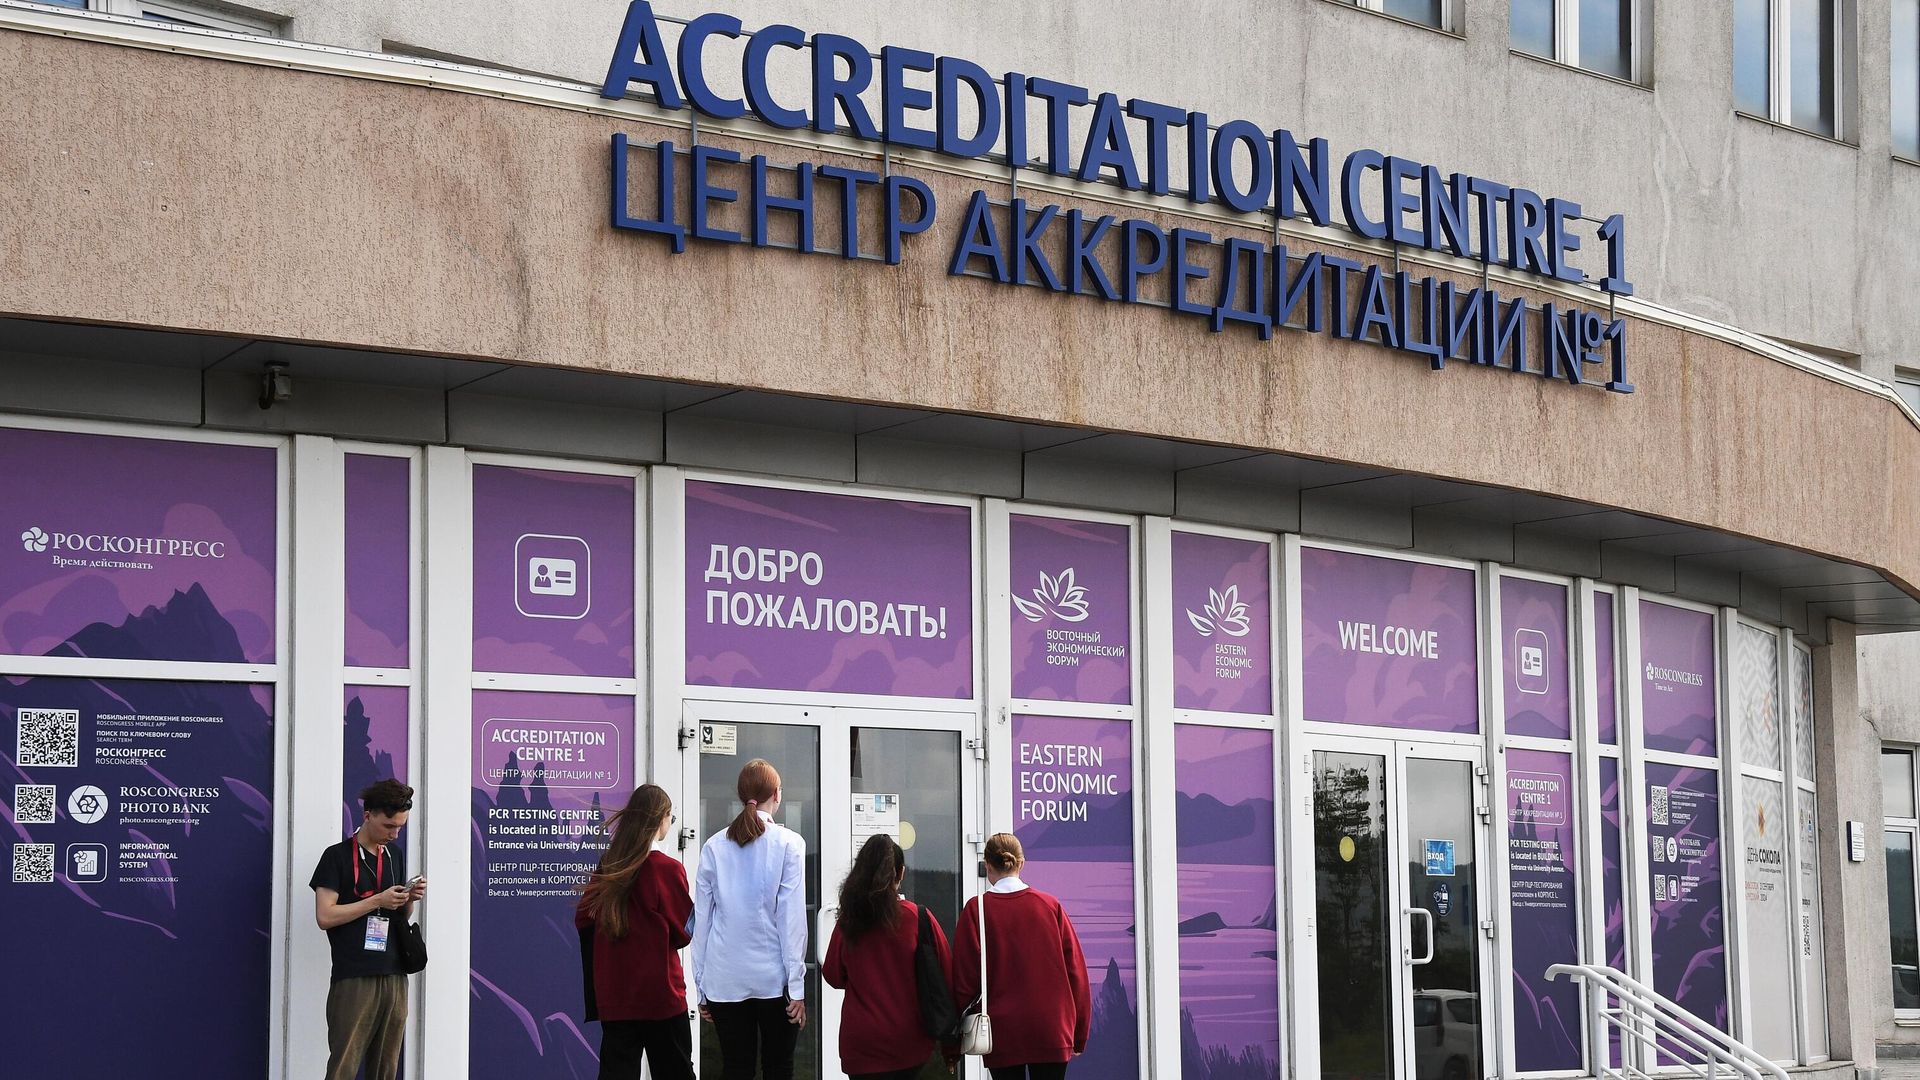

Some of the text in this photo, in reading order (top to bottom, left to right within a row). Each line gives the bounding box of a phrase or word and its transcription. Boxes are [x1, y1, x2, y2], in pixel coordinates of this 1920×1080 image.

[599, 0, 1634, 296] ACCREDITATION CENTRE 1
[611, 133, 936, 265] ЦЕНТР
[948, 189, 1527, 373] АККРЕДИТАЦИИ
[52, 532, 225, 558] РОСКОНГРЕСС
[53, 555, 153, 570] Время действовать
[704, 543, 824, 586] ДОБРО
[706, 589, 947, 639] ПОЖАЛОВАТЬ!
[1047, 629, 1101, 642] ВОСТОЧНЫЙ
[1338, 620, 1439, 660] WELCOME
[1046, 642, 1125, 657] ЭКОНОМИЧЕСКИЙ
[1215, 644, 1247, 656] EASTERN
[1046, 655, 1079, 667] ФОРУМ
[1215, 656, 1252, 669] ECONOMIC
[1215, 668, 1241, 679] FORUM
[1654, 667, 1703, 687] ROSCONGRESS
[492, 728, 605, 746] ACCREDITATION
[96, 748, 166, 758] РОСКОНГРЕСС
[516, 747, 586, 762] CENTRE 1
[1020, 743, 1103, 767] EASTERN
[490, 769, 519, 778] ЦЕНТР
[520, 769, 592, 780] АККРЕДИТАЦИИ
[1020, 771, 1118, 795] ECONOMIC
[1509, 778, 1559, 792] ACCREDITATION
[120, 786, 220, 798] ROSCONGRESS
[1520, 792, 1551, 804] CENTRE 1
[120, 803, 211, 814] PHOTO BANK
[489, 808, 599, 820] PCR TESTING CENTRE
[1021, 799, 1088, 822] FORUM
[120, 817, 200, 825] photo.roscongress.org
[489, 824, 497, 834] is
[500, 824, 536, 835] located
[539, 825, 548, 835] in
[551, 825, 600, 835] BUILDING
[488, 841, 525, 850] Entrance
[526, 841, 538, 850] via
[540, 841, 580, 852] University
[1510, 839, 1520, 848] PCR
[1520, 840, 1540, 849] TESTING
[1427, 852, 1445, 861] ВХОД
[119, 861, 148, 869] SYSTEM
[488, 863, 517, 873] ЦЕНТР
[488, 877, 539, 886] расположен
[548, 876, 586, 885] КОРПУСЕ
[488, 889, 509, 897] Въезд
[516, 889, 576, 898] Университетского
